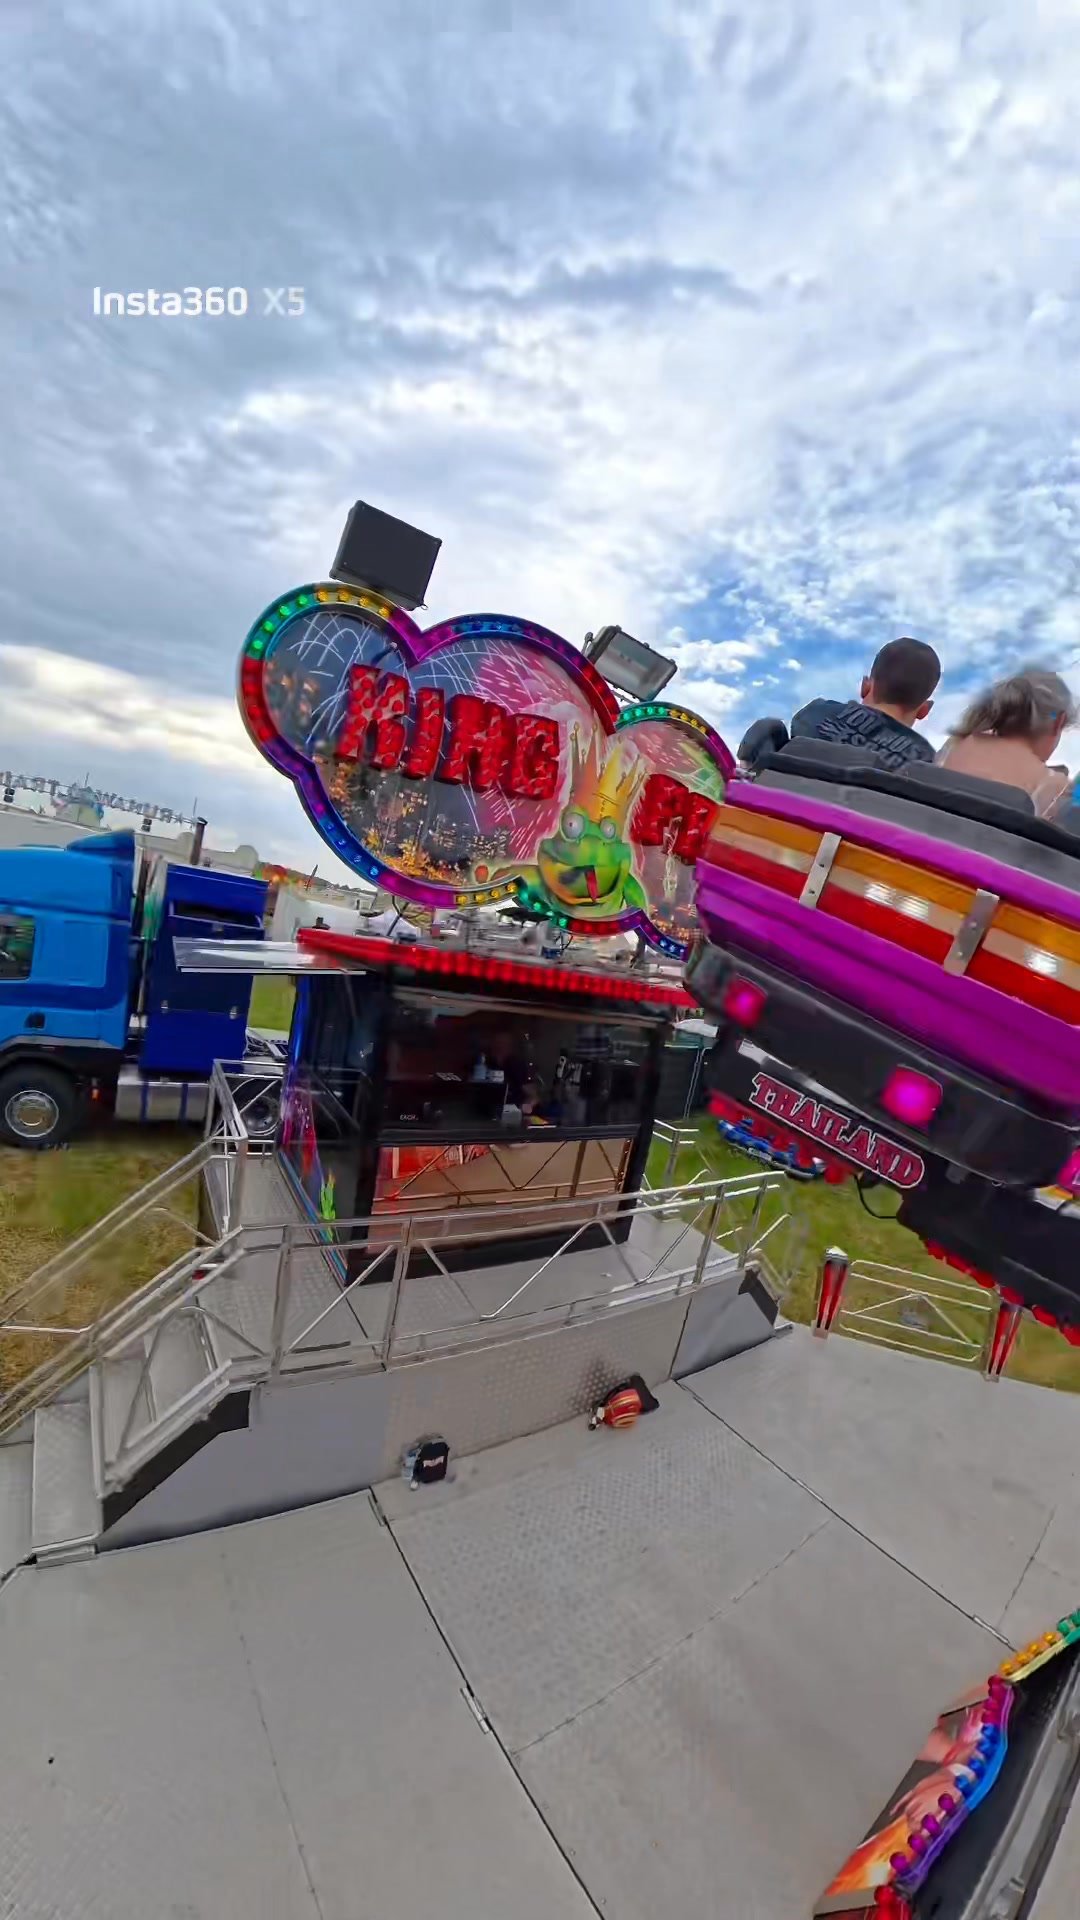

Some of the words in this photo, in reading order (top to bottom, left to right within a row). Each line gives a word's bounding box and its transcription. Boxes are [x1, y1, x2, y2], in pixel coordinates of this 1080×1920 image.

[333, 663, 560, 800] KING
[836, 703, 881, 735] YOU
[749, 1072, 925, 1189] THAILAND
